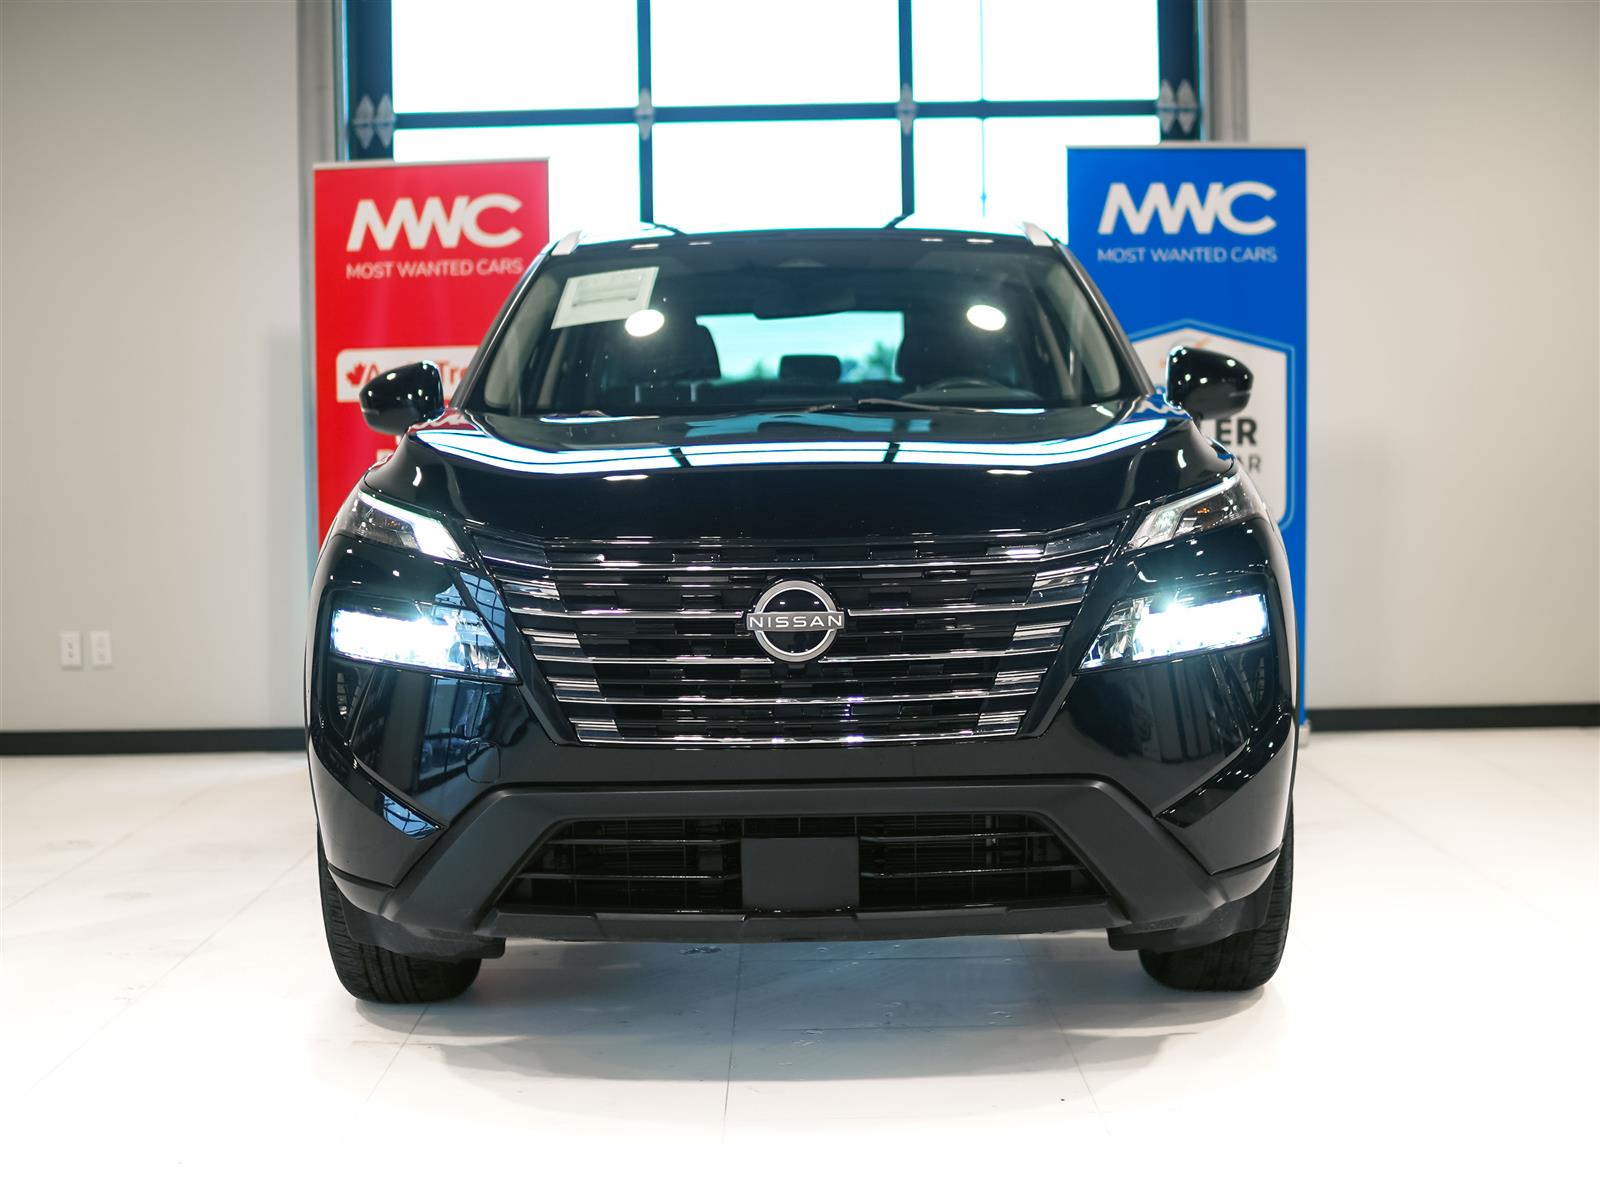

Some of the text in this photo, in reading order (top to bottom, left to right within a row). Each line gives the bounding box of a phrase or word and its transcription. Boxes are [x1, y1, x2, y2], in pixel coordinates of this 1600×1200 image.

[1097, 181, 1278, 236] MWC
[346, 193, 523, 252] MWC
[1097, 246, 1278, 263] MOST WANTED CARS
[345, 256, 524, 280] MOST WANTED CARS
[749, 615, 842, 629] NISSAN
